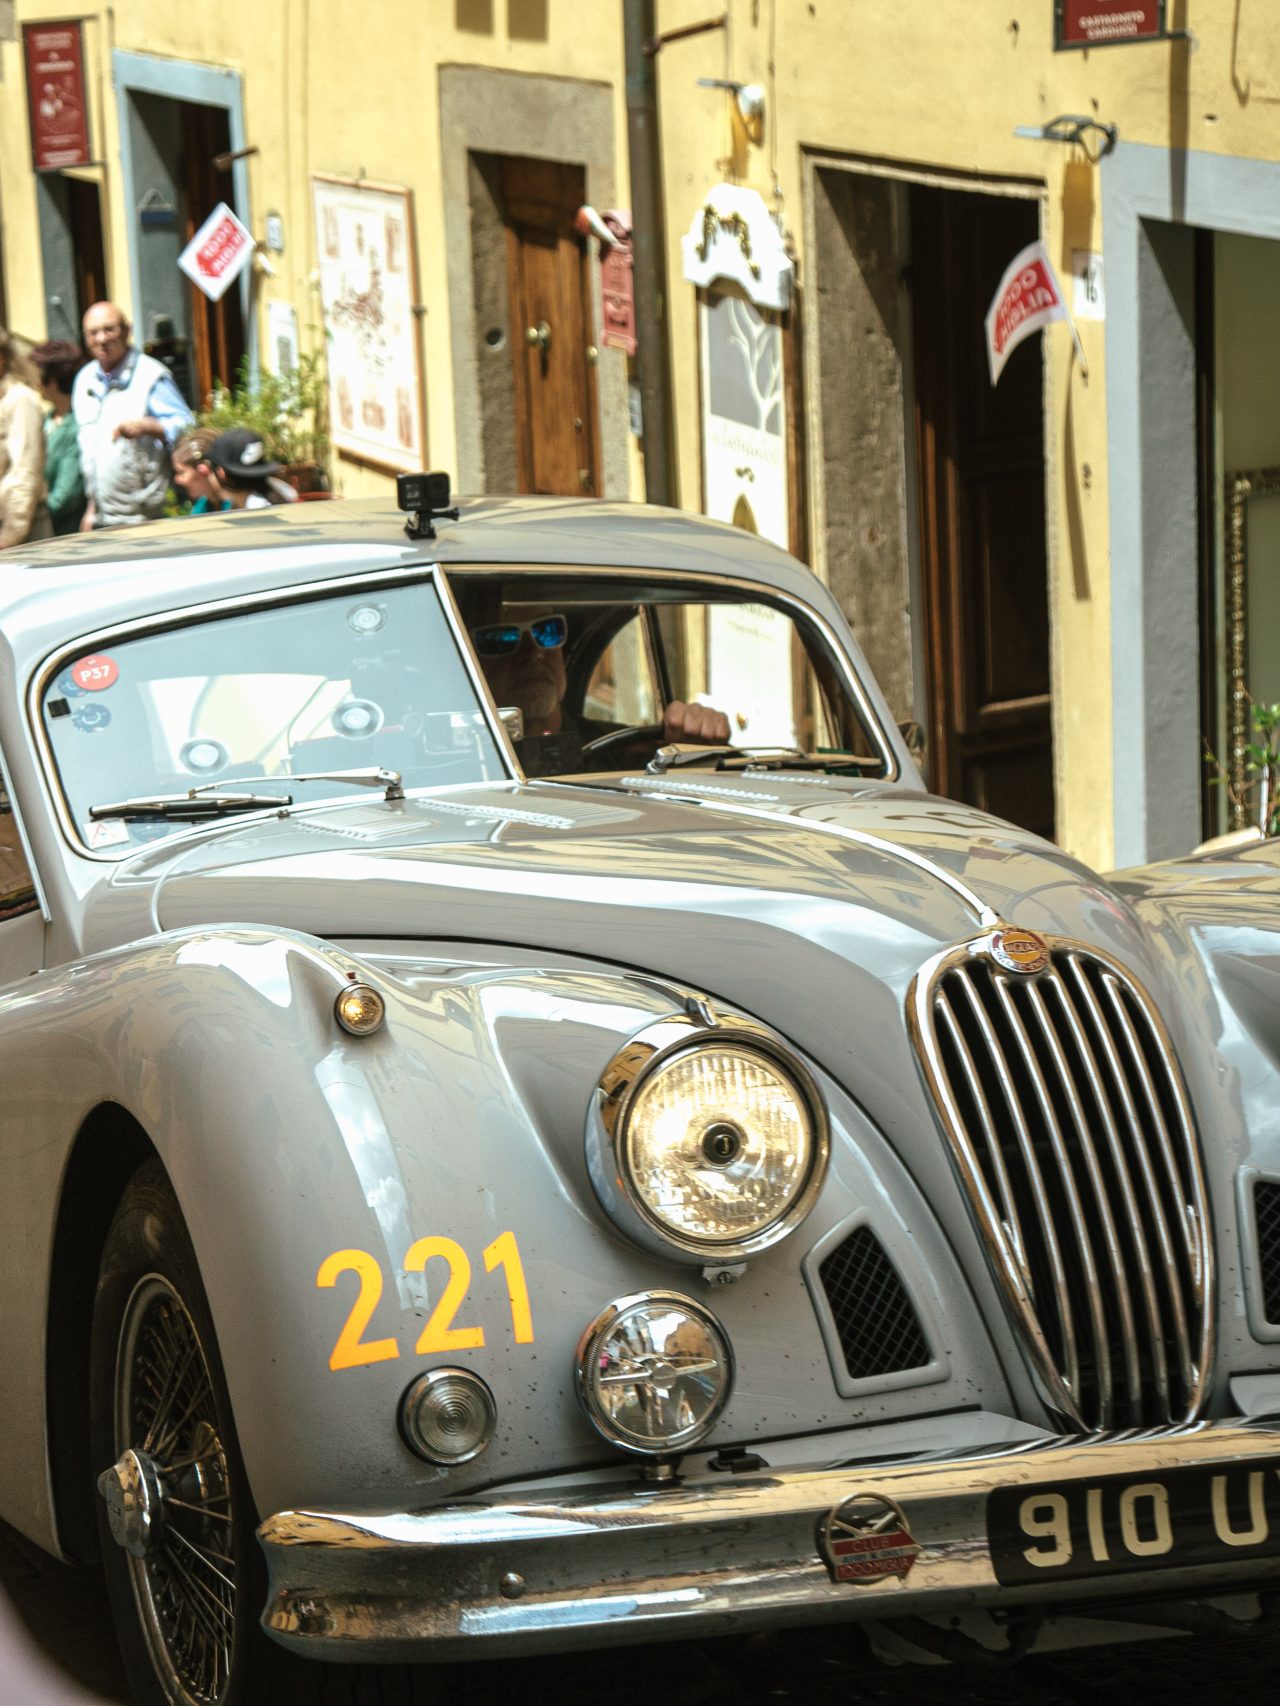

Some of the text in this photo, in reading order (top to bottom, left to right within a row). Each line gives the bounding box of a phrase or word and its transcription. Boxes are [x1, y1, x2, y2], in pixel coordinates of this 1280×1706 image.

[80, 664, 111, 683] P37
[316, 1231, 534, 1371] 221
[852, 1537, 889, 1552] CLUB
[1020, 1470, 1280, 1568] 910 U
